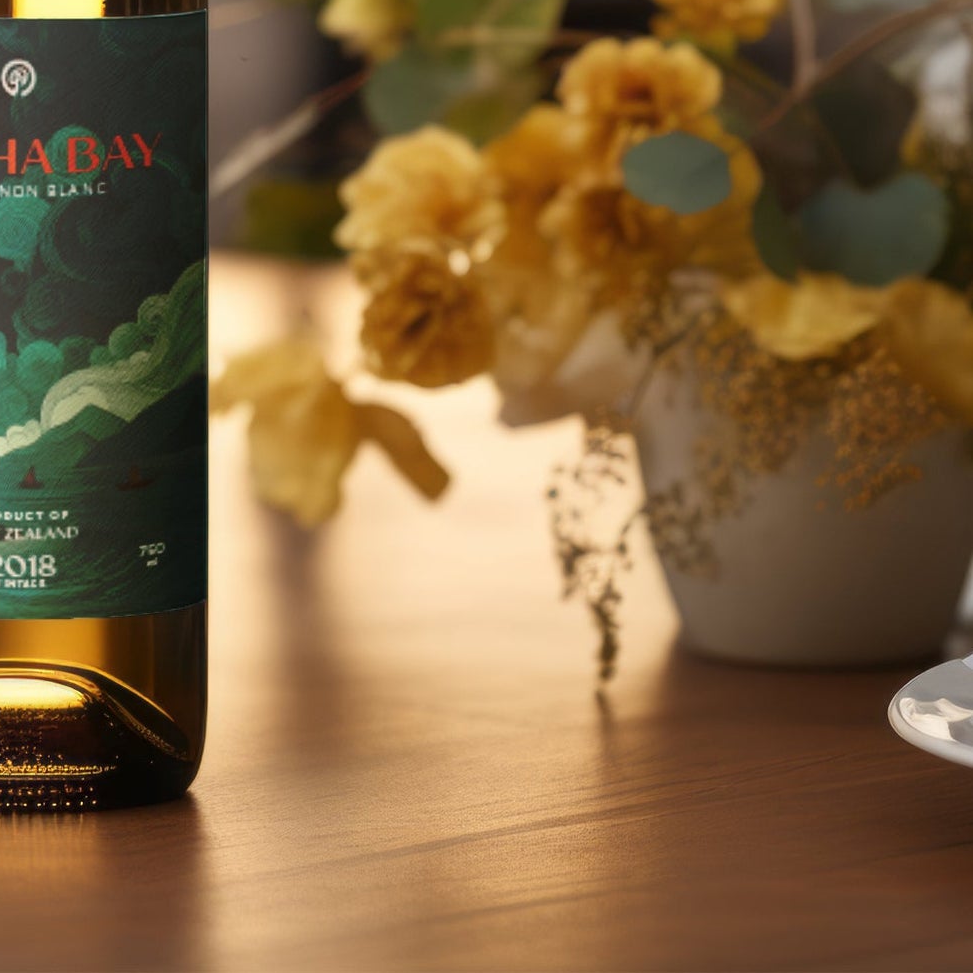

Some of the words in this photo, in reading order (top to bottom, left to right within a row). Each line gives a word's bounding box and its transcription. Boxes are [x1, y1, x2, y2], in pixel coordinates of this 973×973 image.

[67, 132, 163, 173] BAY
[47, 182, 108, 197] BLANC
[49, 510, 69, 520] OF
[4, 526, 79, 540] ZEALAND
